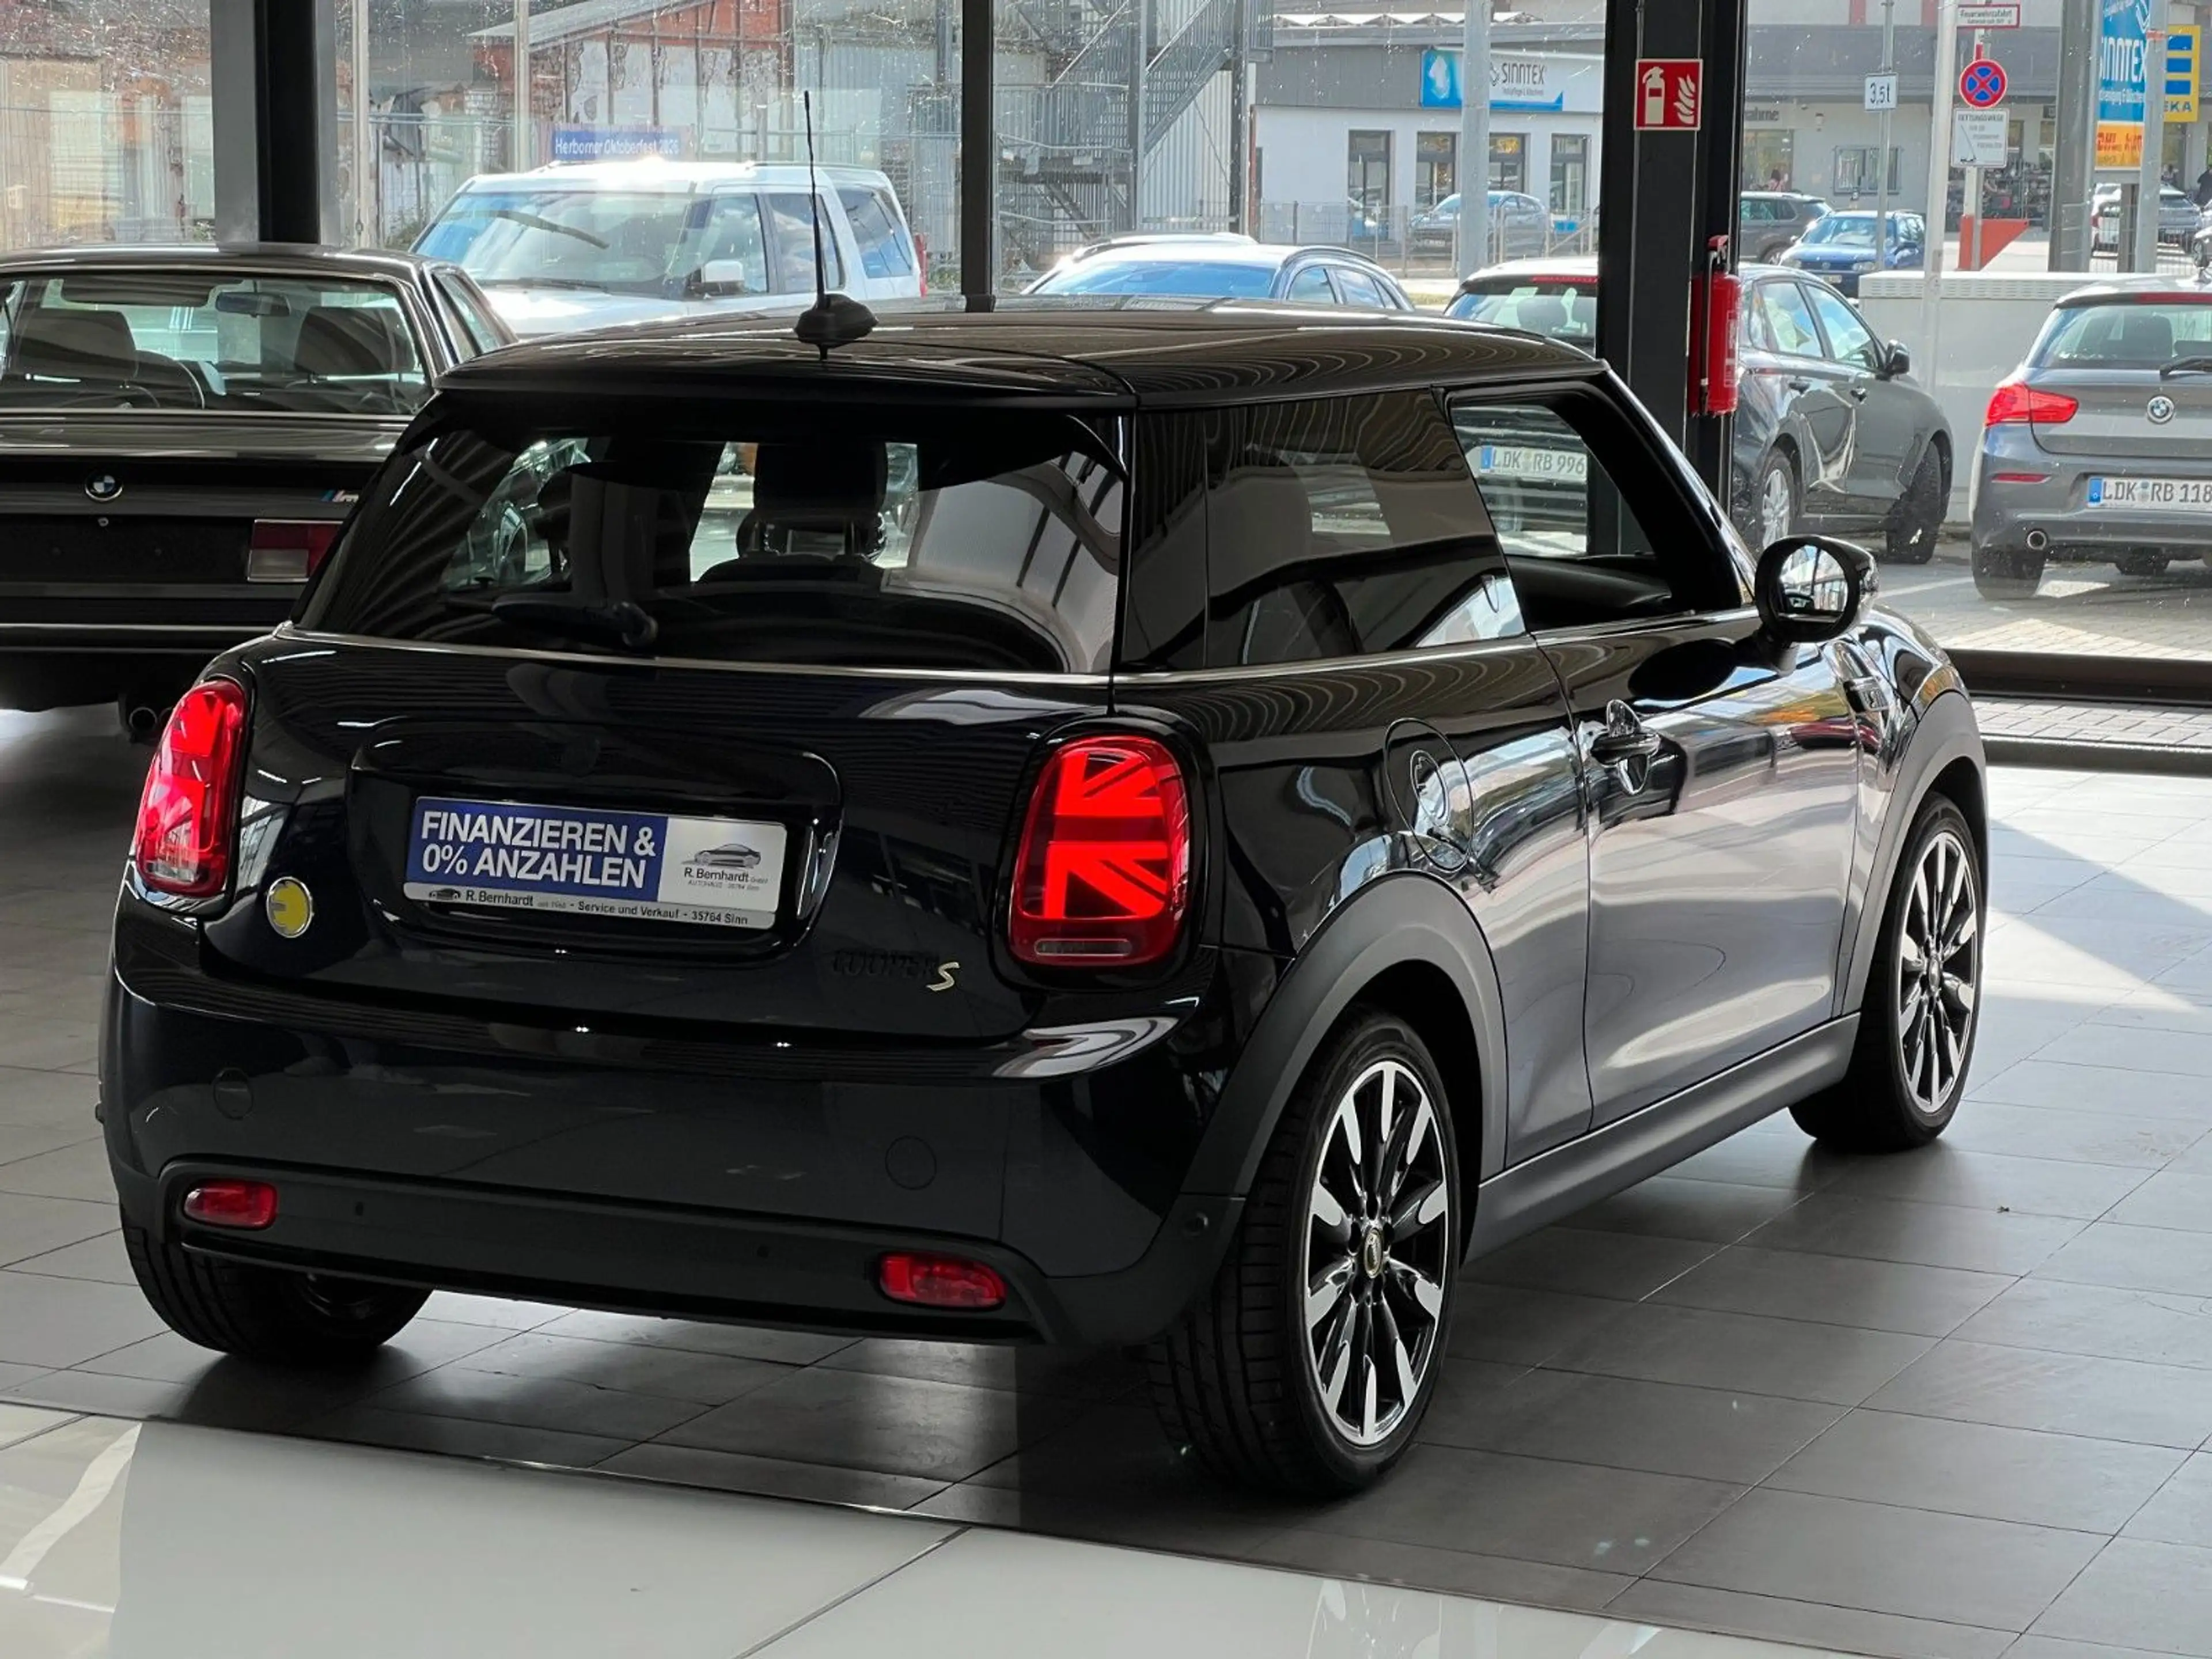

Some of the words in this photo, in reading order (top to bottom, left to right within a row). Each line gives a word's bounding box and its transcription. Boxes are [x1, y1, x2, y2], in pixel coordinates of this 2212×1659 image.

[1501, 62, 1545, 85] SINNTEX
[1492, 449, 1522, 468] LDK
[1532, 453, 1552, 473] RB
[1557, 454, 1585, 475] 996
[2103, 480, 2137, 502] LDK
[2151, 482, 2174, 502] RB
[421, 811, 628, 854] FINANZIEREN
[634, 826, 656, 857] &
[423, 843, 468, 875] 0%
[473, 847, 646, 889] ANZAHLEN
[696, 868, 749, 882] Bernhardt
[479, 892, 533, 907] Bernhardt
[577, 900, 615, 914] Service
[618, 904, 638, 914] und
[641, 907, 679, 919] Verkauf
[691, 911, 721, 922] 35764
[724, 912, 748, 925] Sinn
[925, 960, 961, 992] S
